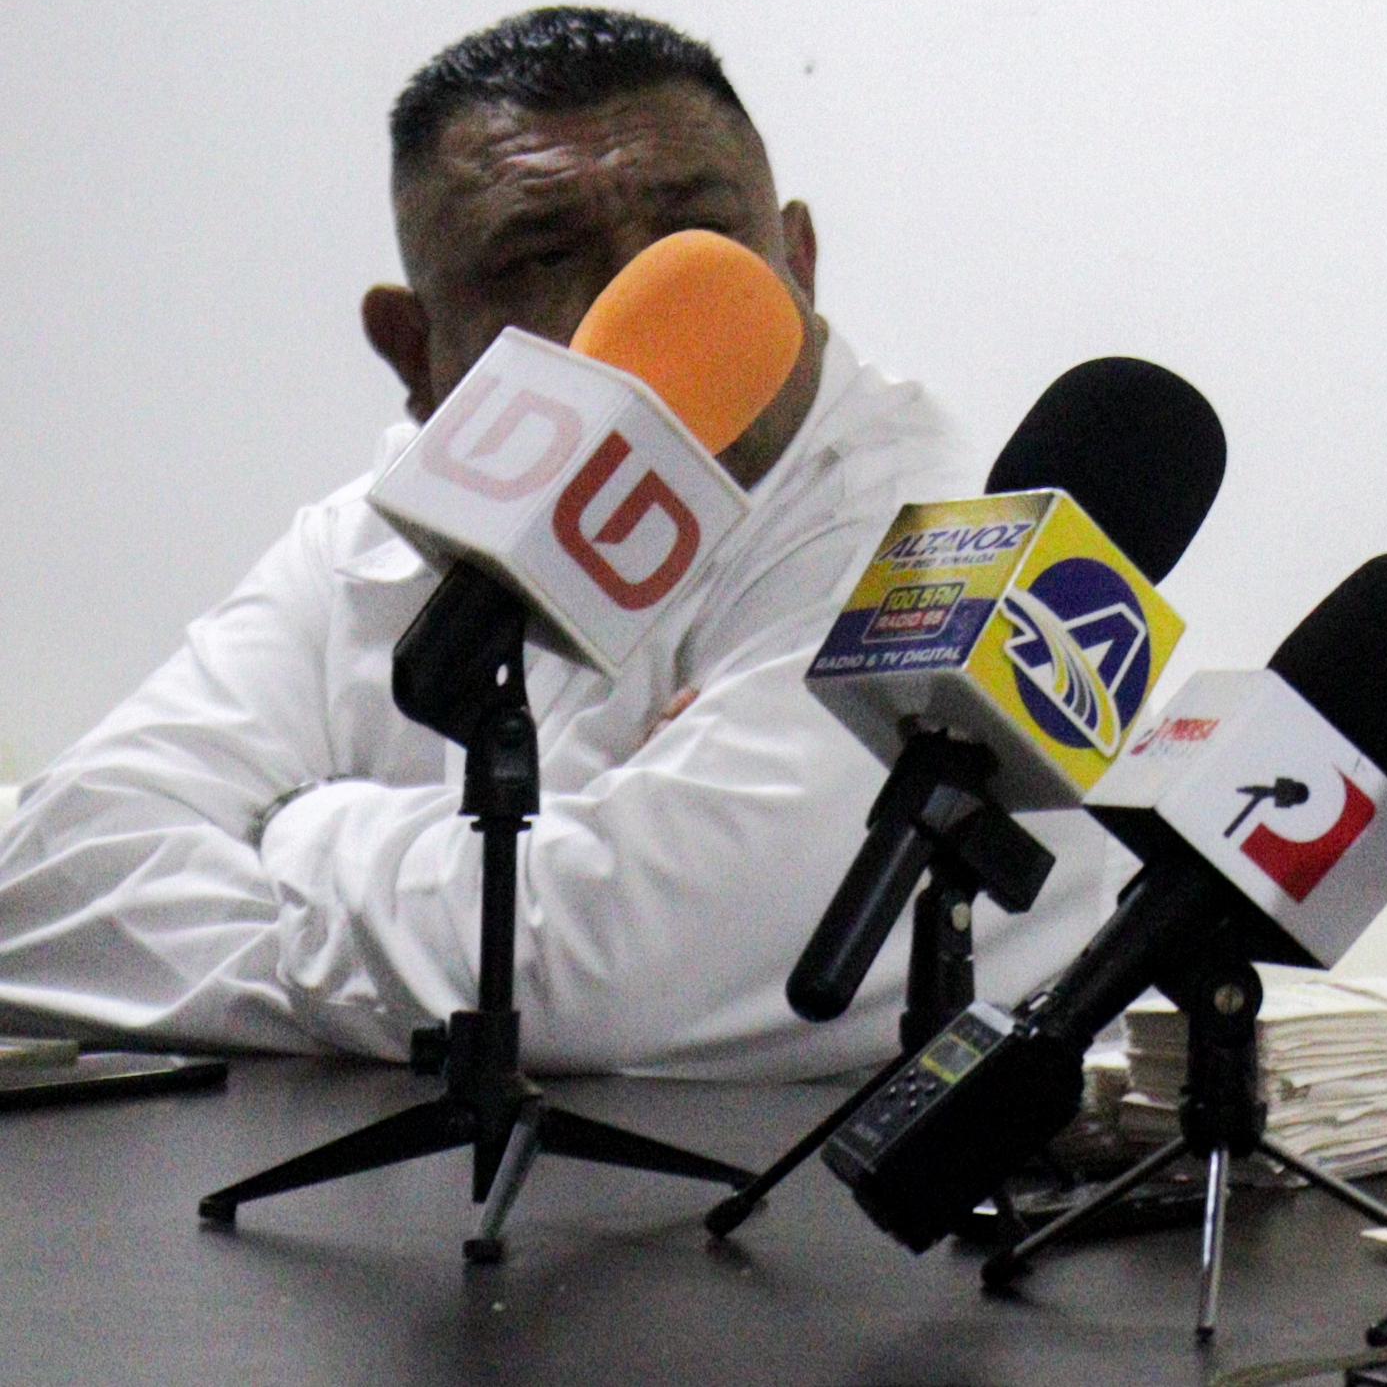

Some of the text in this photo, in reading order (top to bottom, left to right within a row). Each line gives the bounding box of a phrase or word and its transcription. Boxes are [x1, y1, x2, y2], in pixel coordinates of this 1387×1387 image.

[813, 654, 865, 670] RADIO
[882, 651, 905, 666] TV
[901, 646, 962, 666] DIGITAL
